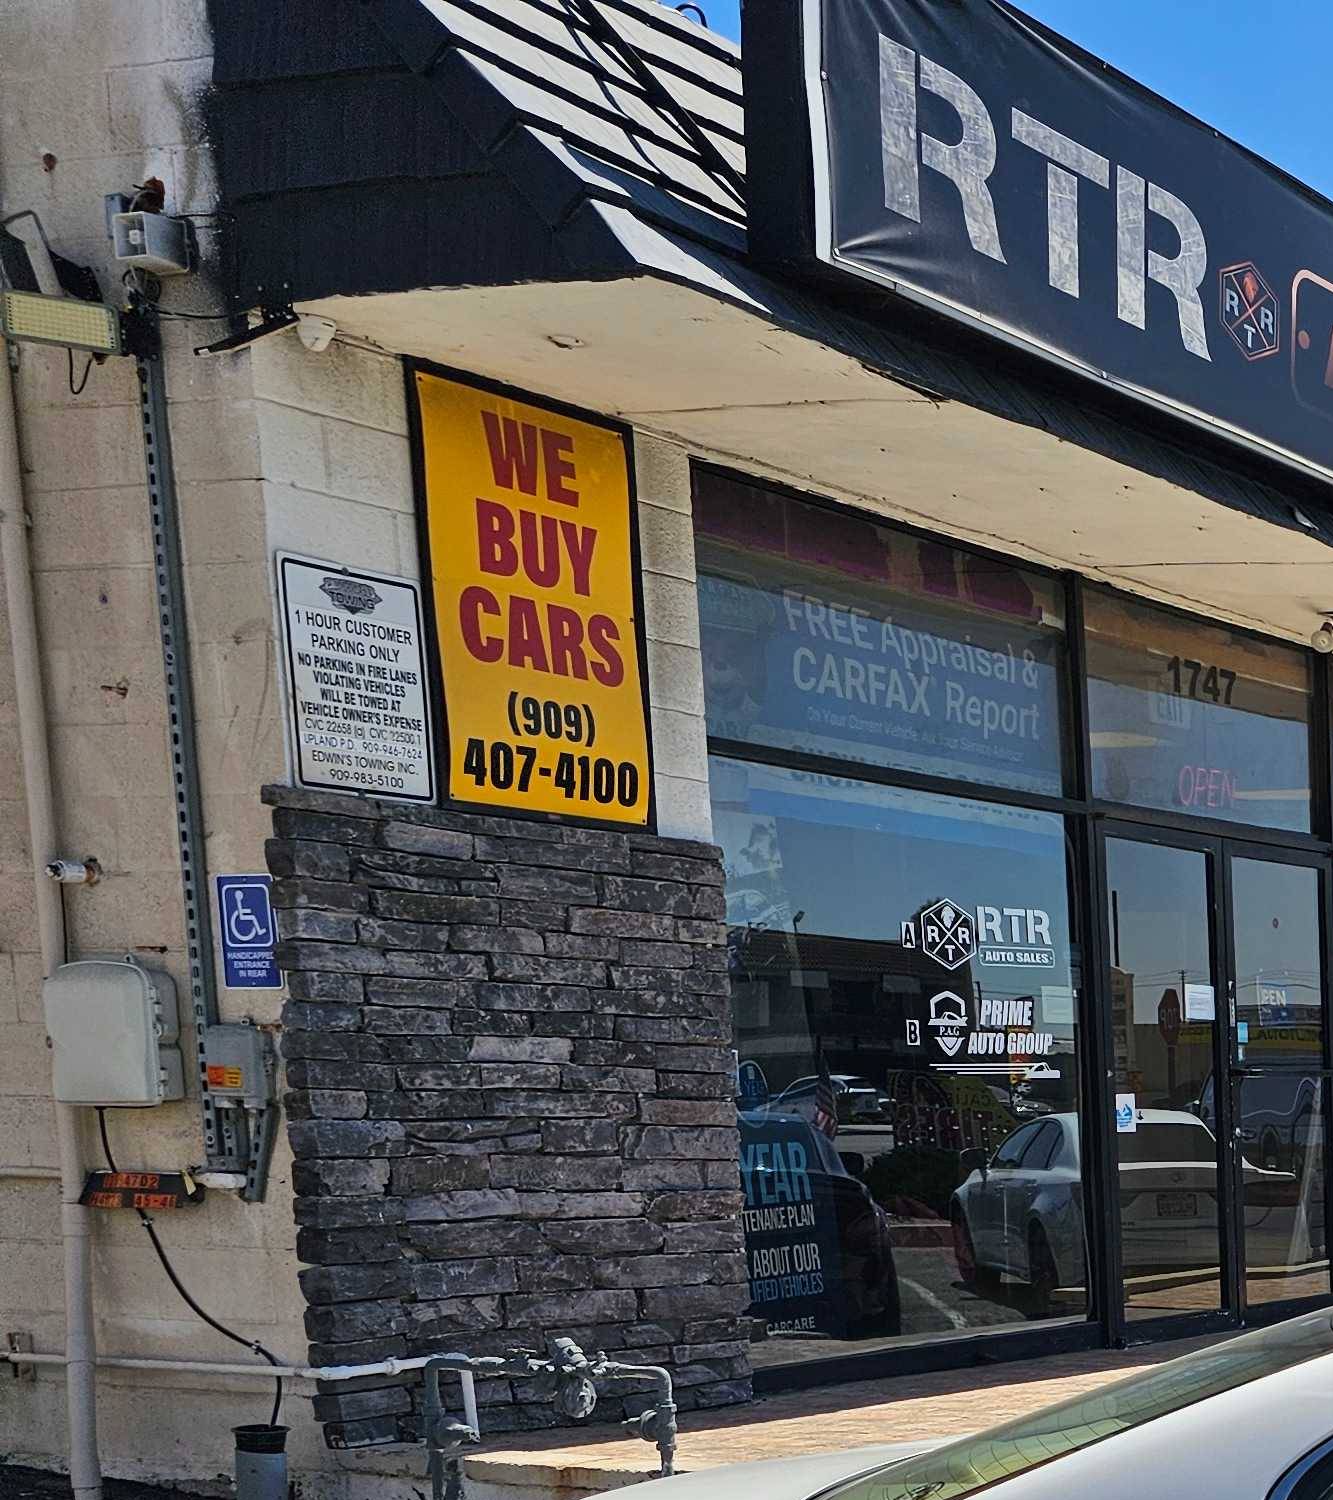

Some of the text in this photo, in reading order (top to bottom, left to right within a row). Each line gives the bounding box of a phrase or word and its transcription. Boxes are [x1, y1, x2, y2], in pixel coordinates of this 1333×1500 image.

[878, 33, 1212, 363] RTR
[481, 411, 579, 506] WE
[476, 498, 597, 597] BUY
[295, 609, 412, 645] 1 HOUR CUSTOMER
[459, 586, 624, 687] CARS
[784, 589, 1040, 689] FREE Appraisal &
[311, 633, 400, 663] PARKING ONLY
[297, 652, 417, 685] NO PARKING IN FIRE LANES
[313, 670, 406, 697] VIOLATING VEHICLES
[1167, 655, 1237, 705] 1747
[320, 688, 402, 712] WILL BE TOWED AT
[792, 646, 1041, 741] CARFAX Report
[300, 700, 422, 732] VEHICLE OWNER'S EXPENSE
[305, 717, 324, 731] CVC
[508, 691, 595, 746] (909)
[312, 750, 353, 767] EDWIN'S
[354, 755, 396, 772] TOWING
[463, 738, 639, 807] 407-4100
[329, 768, 404, 789] 909-983-5100
[1178, 765, 1239, 808] OPEN
[976, 906, 1052, 945] RTR
[985, 952, 1049, 963] AUTO SALES
[980, 1000, 1032, 1026] PRIME
[968, 1033, 1053, 1055] AUTO GROUP
[740, 1142, 813, 1206] YEAR
[788, 1204, 815, 1228] PLAN
[753, 1242, 822, 1279] ABOUT OUR
[779, 1272, 824, 1299] VEHICLES
[767, 1316, 816, 1333] CARCARE
